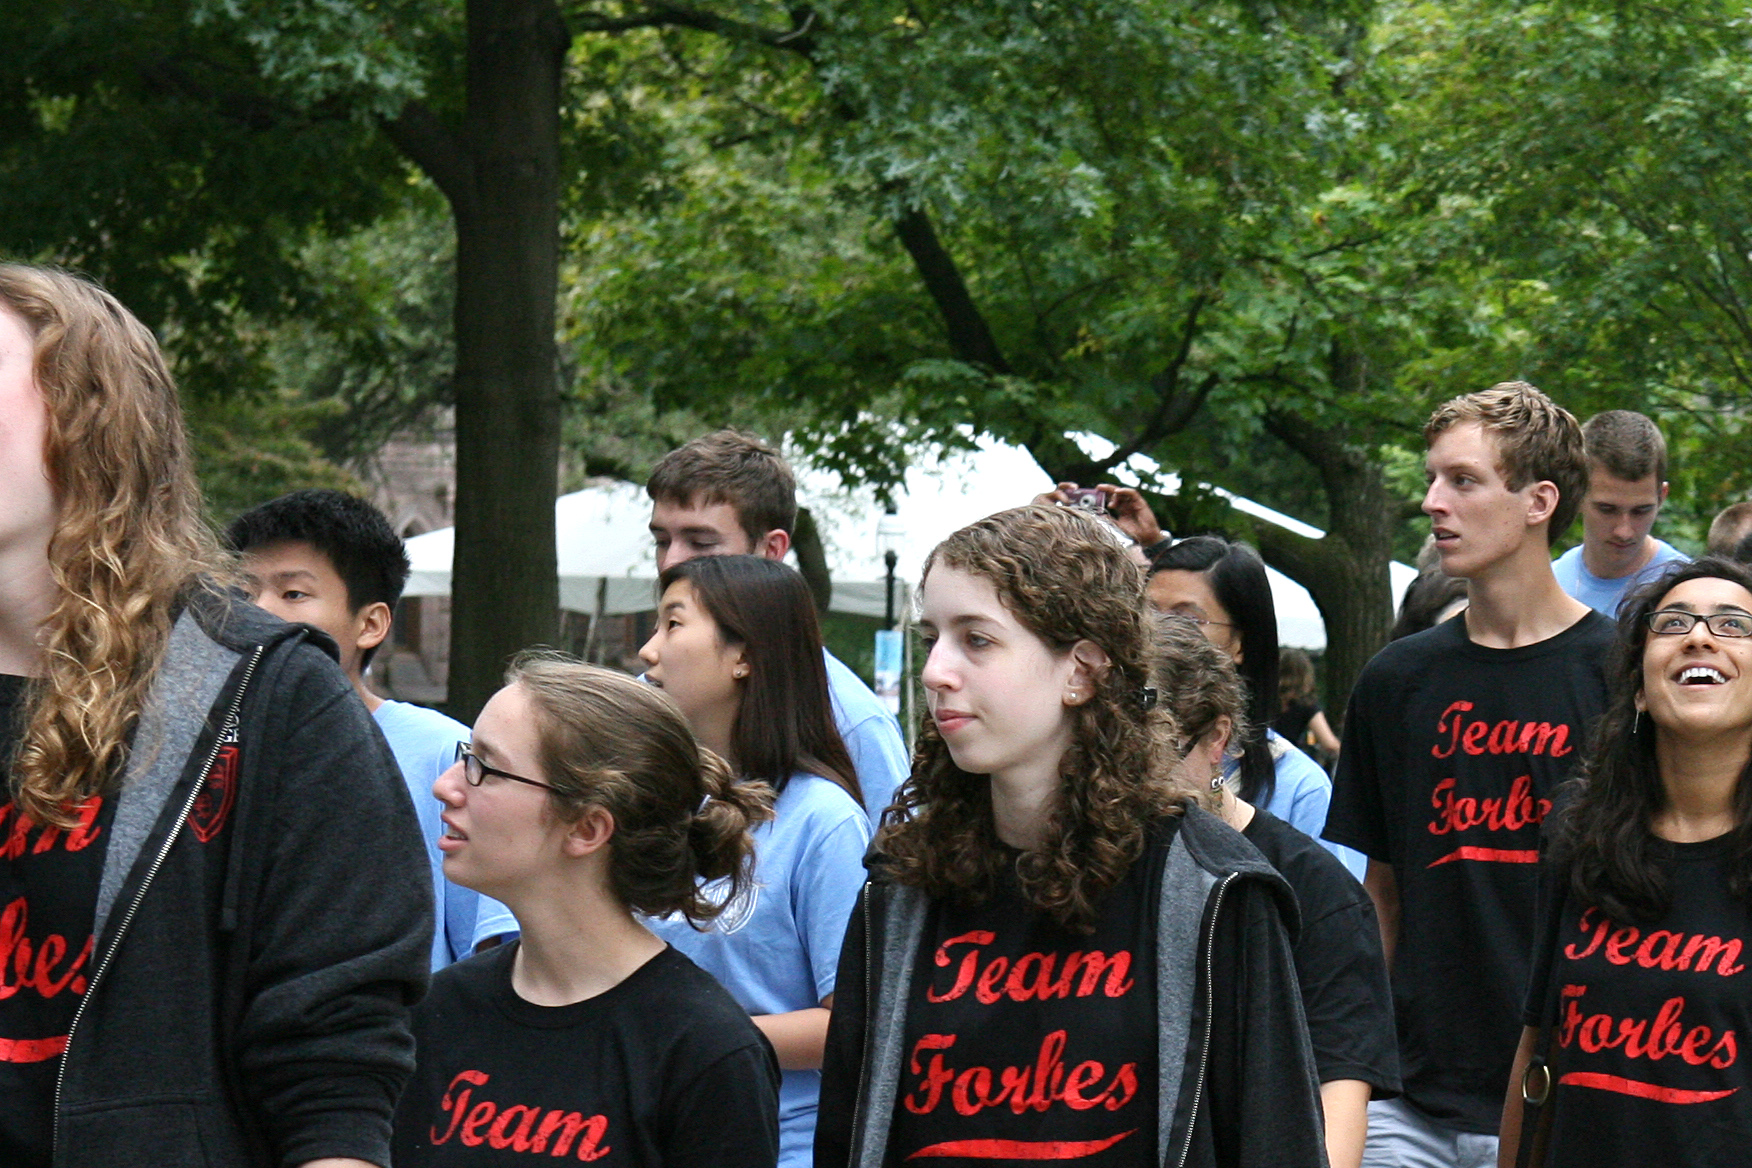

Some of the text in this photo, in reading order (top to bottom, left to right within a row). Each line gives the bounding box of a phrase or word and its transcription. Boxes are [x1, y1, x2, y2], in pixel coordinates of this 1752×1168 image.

[1431, 700, 1573, 758] Team
[1427, 775, 1553, 836] Forbe
[926, 930, 1135, 1004] Team
[1564, 906, 1745, 977] Team
[1559, 983, 1738, 1069] Forbes
[904, 1029, 1139, 1116] Forbes
[430, 1069, 610, 1162] Team
